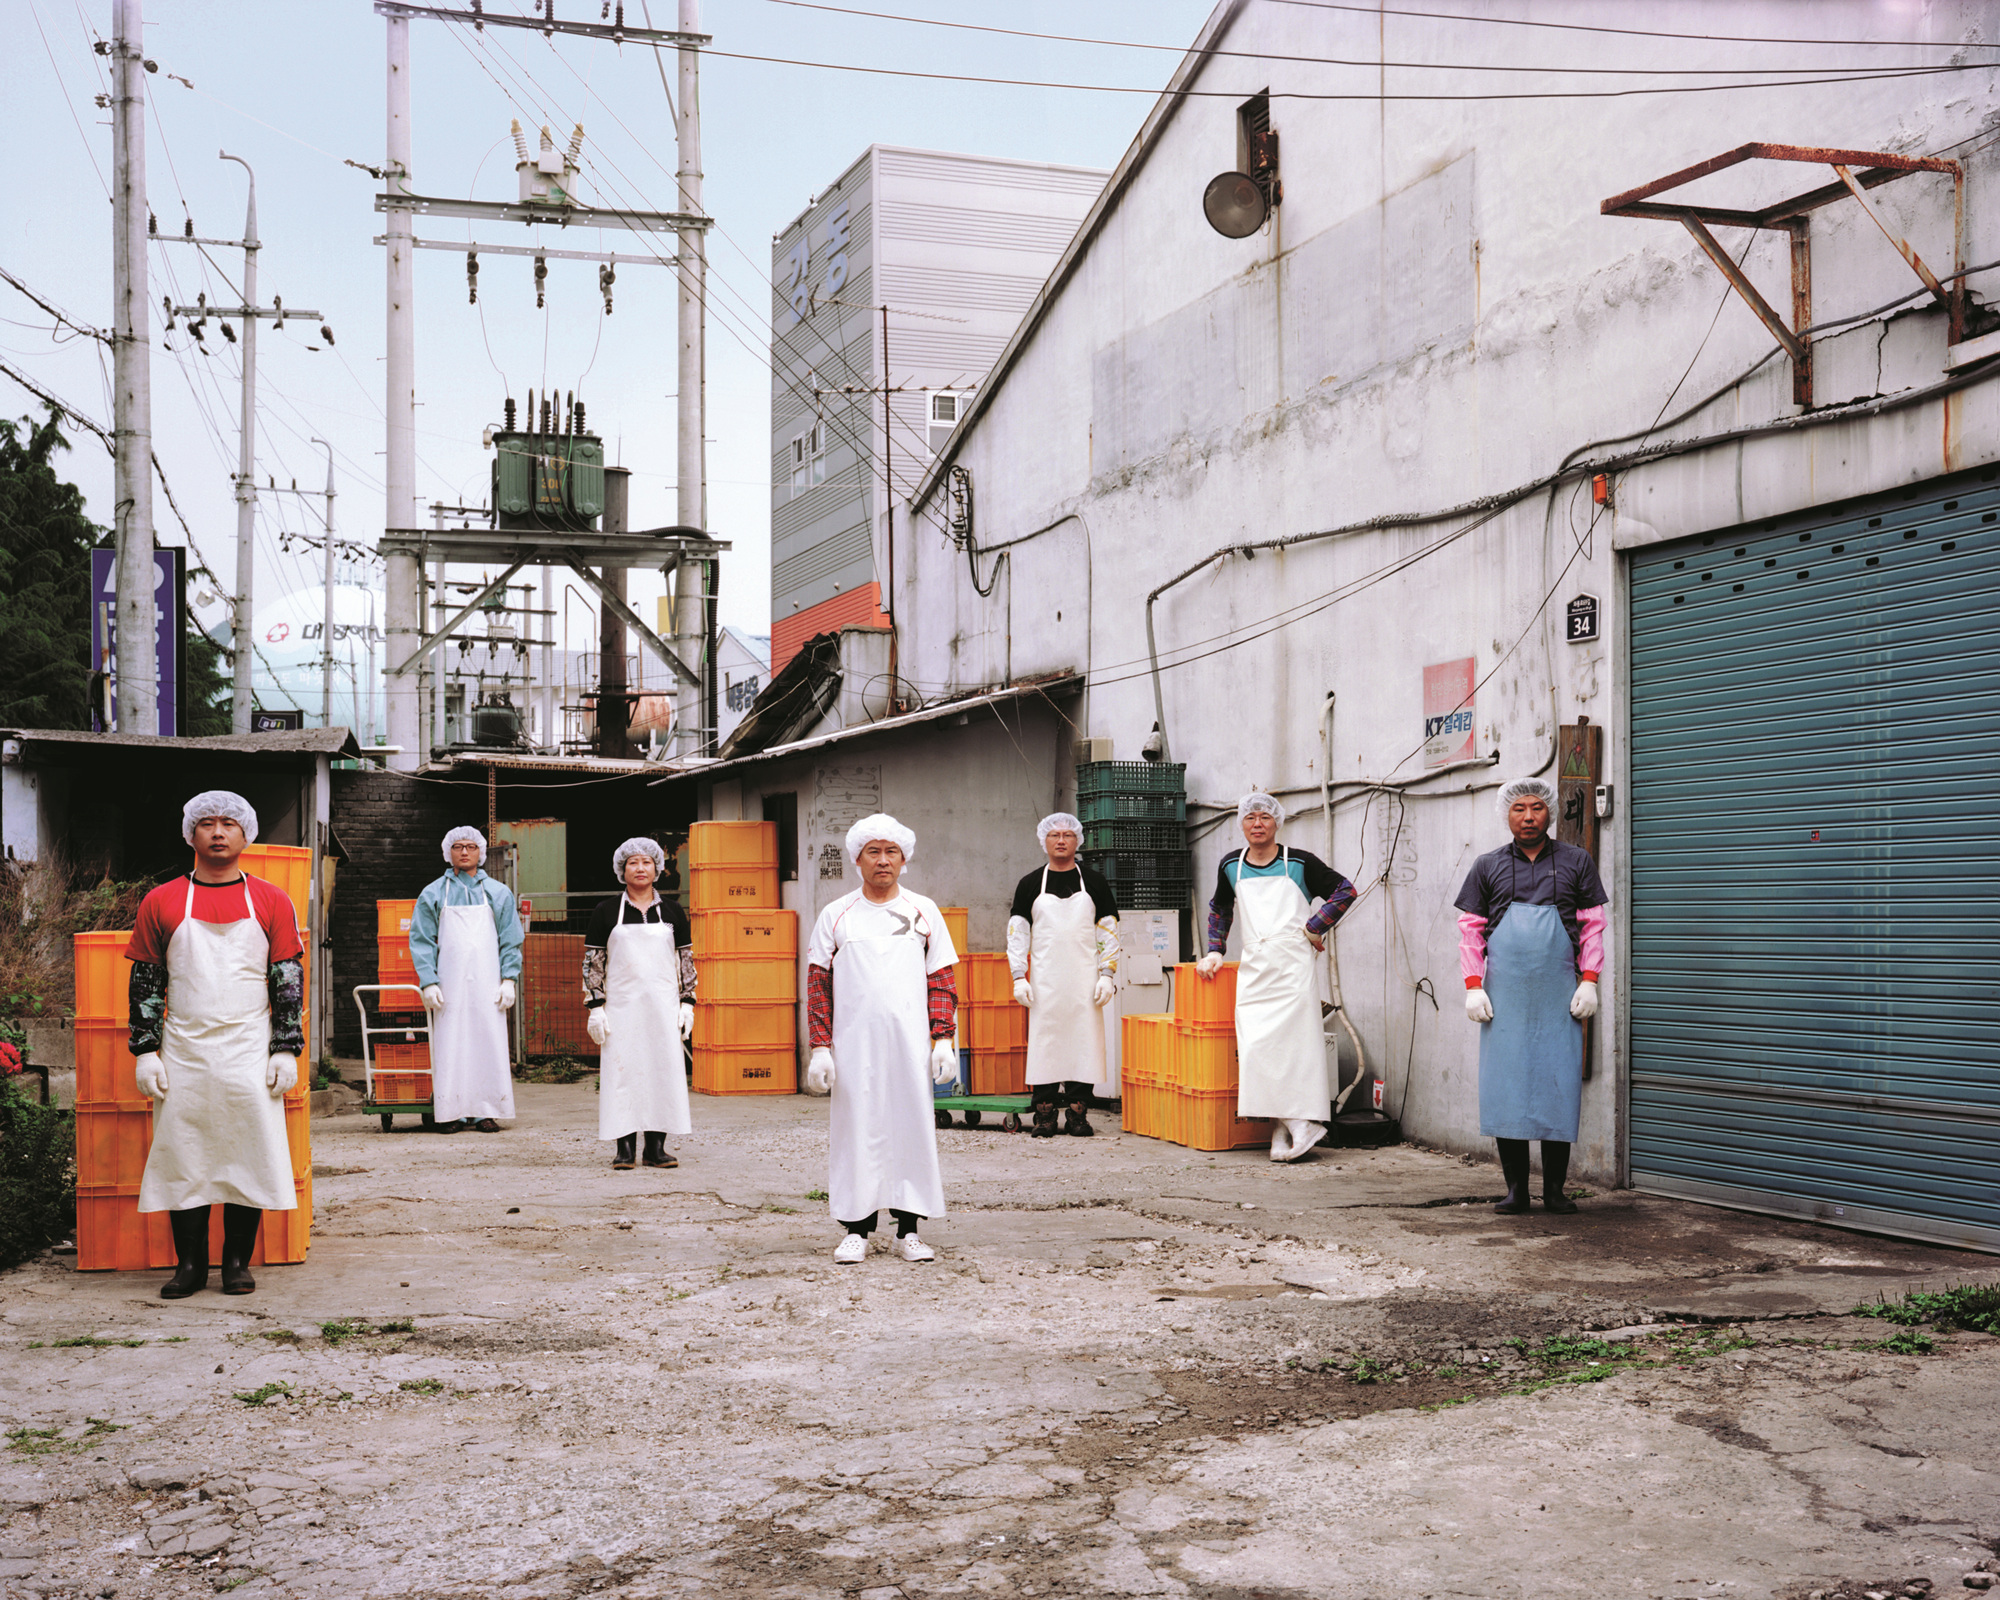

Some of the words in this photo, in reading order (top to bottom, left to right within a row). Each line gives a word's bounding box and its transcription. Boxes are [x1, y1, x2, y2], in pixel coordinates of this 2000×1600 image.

[789, 198, 850, 325] 강동
[1573, 616, 1590, 636] 34
[1425, 711, 1473, 737] KT텔레캅
[1564, 787, 1584, 835] 대
